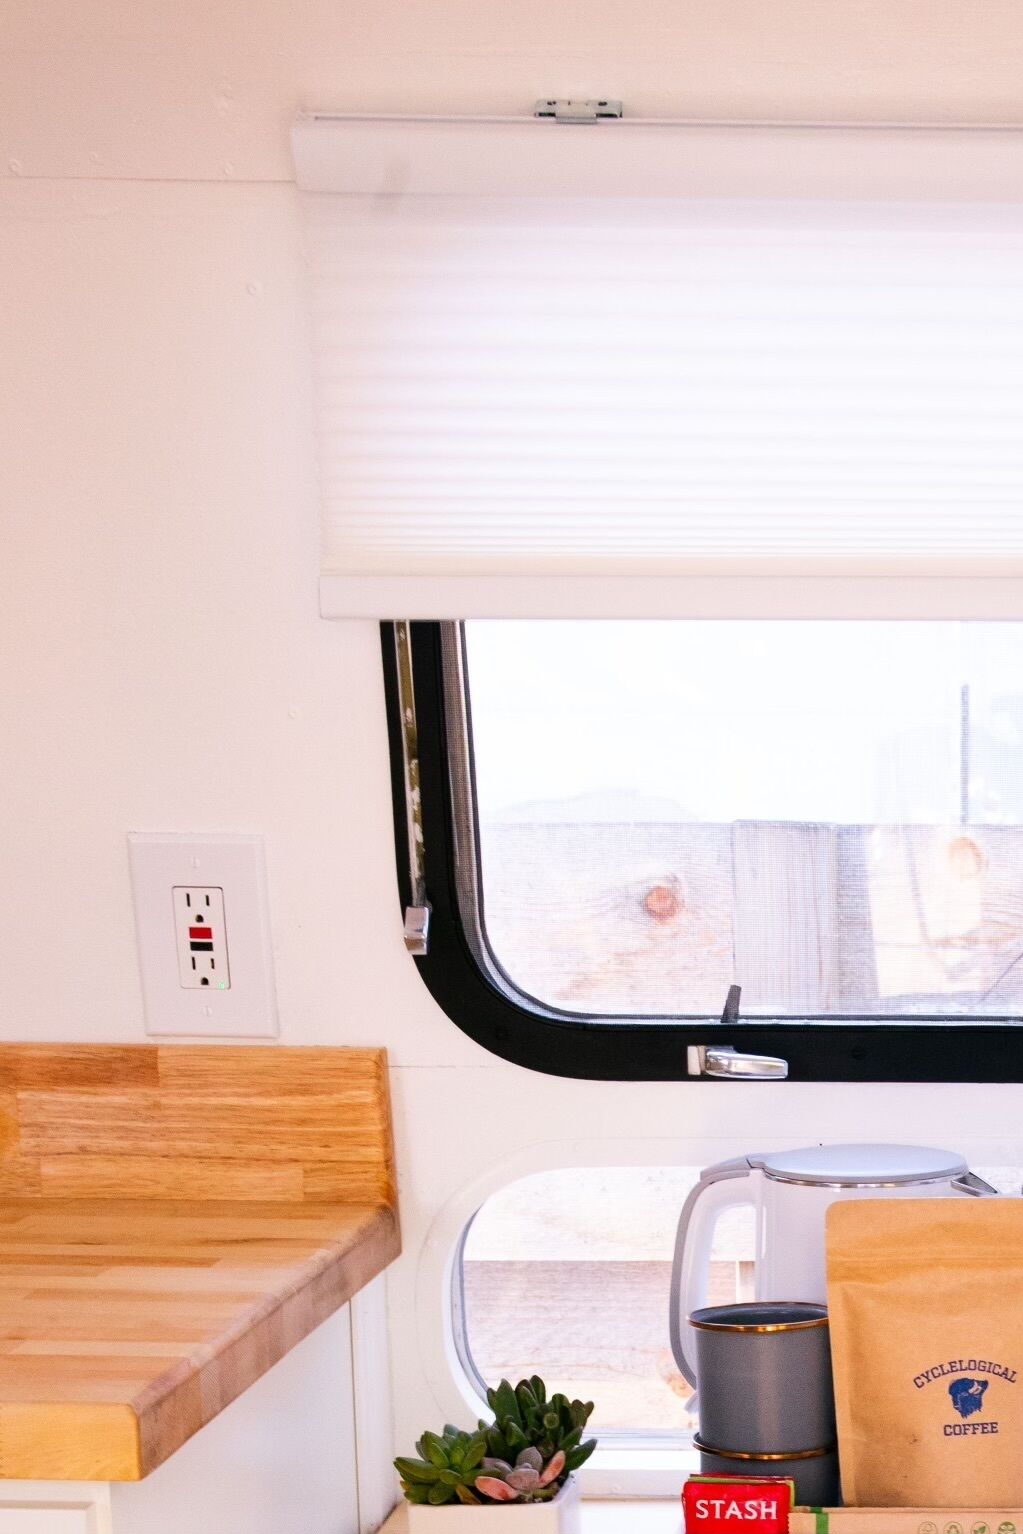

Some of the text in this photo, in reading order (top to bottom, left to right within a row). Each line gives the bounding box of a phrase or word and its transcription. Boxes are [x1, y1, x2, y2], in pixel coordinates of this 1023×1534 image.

[913, 1359, 1018, 1389] CYCLELOGICAL
[943, 1422, 999, 1436] COFFEE
[695, 1499, 778, 1520] STASH
